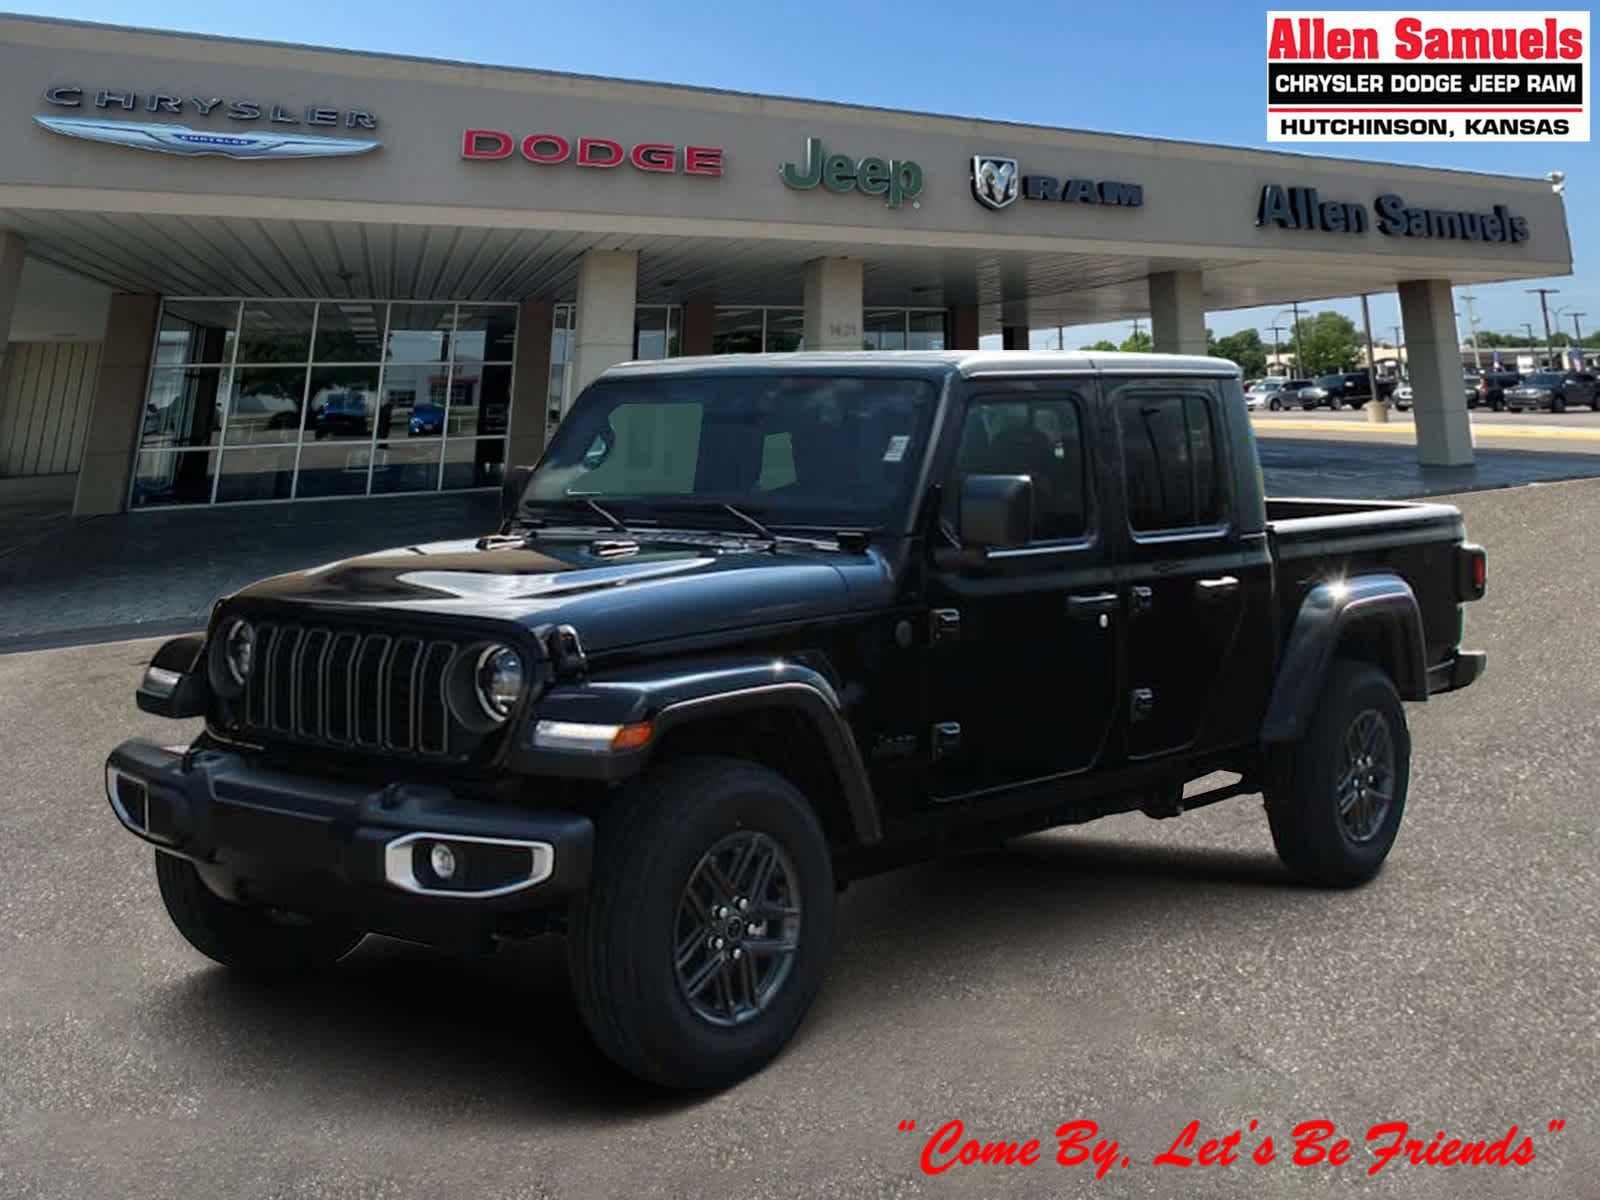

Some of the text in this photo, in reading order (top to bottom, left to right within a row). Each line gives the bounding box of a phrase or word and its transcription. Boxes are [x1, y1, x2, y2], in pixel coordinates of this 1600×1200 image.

[45, 86, 378, 129] CHRYSLER
[462, 128, 725, 177] DODGE
[780, 137, 922, 209] Jeep
[1022, 174, 1144, 207] RAM
[1256, 184, 1530, 243] Allen Samuels
